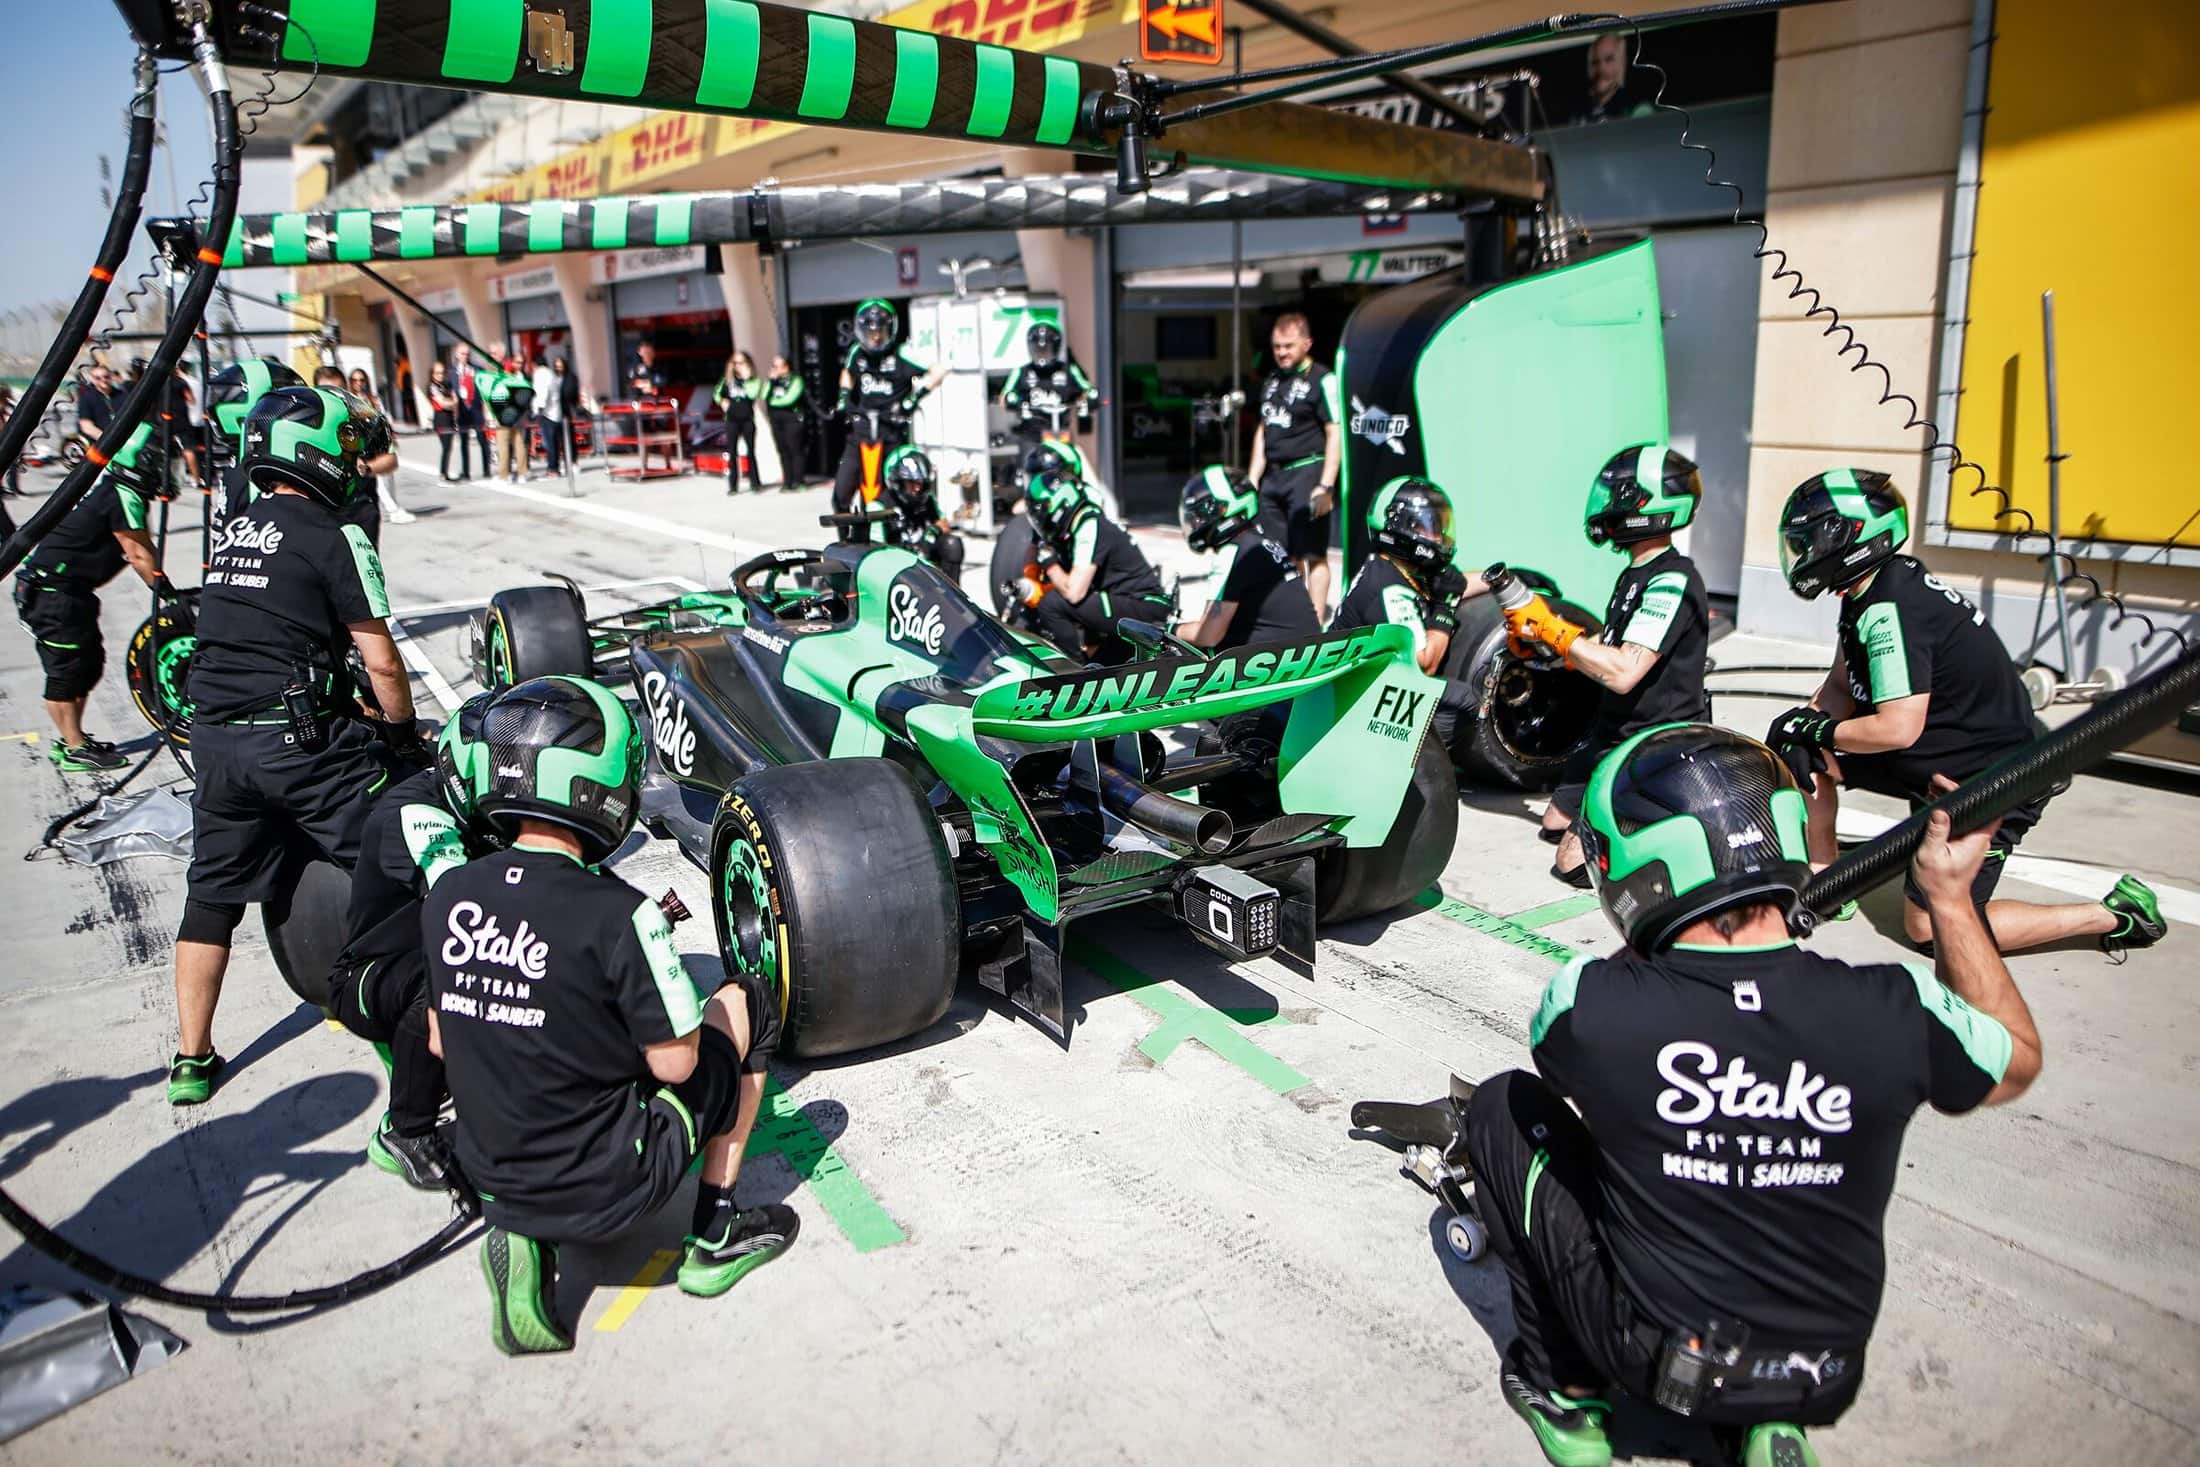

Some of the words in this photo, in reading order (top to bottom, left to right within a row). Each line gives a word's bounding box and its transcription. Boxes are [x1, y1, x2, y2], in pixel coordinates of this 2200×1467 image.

[631, 115, 694, 172] DHL
[1348, 252, 1381, 282] 77
[1353, 418, 1405, 434] SUNOCO
[214, 516, 284, 555] Stake
[231, 557, 263, 569] TEAM
[229, 574, 270, 589] SAUBER
[889, 584, 945, 656] Stake
[1373, 685, 1425, 728] FIX
[643, 671, 697, 777] Stake
[1367, 719, 1411, 742] NETWORK
[731, 794, 773, 869] ZERO
[1210, 888, 1233, 905] CODE
[442, 900, 549, 980] Stake
[481, 976, 530, 1000] TEAM
[485, 1002, 546, 1027] SAUBER
[1656, 1040, 1853, 1134] Stake
[1736, 1134, 1821, 1158] TEAM
[1662, 1152, 1729, 1186] KICK
[1751, 1162, 1844, 1188] SAUBER
